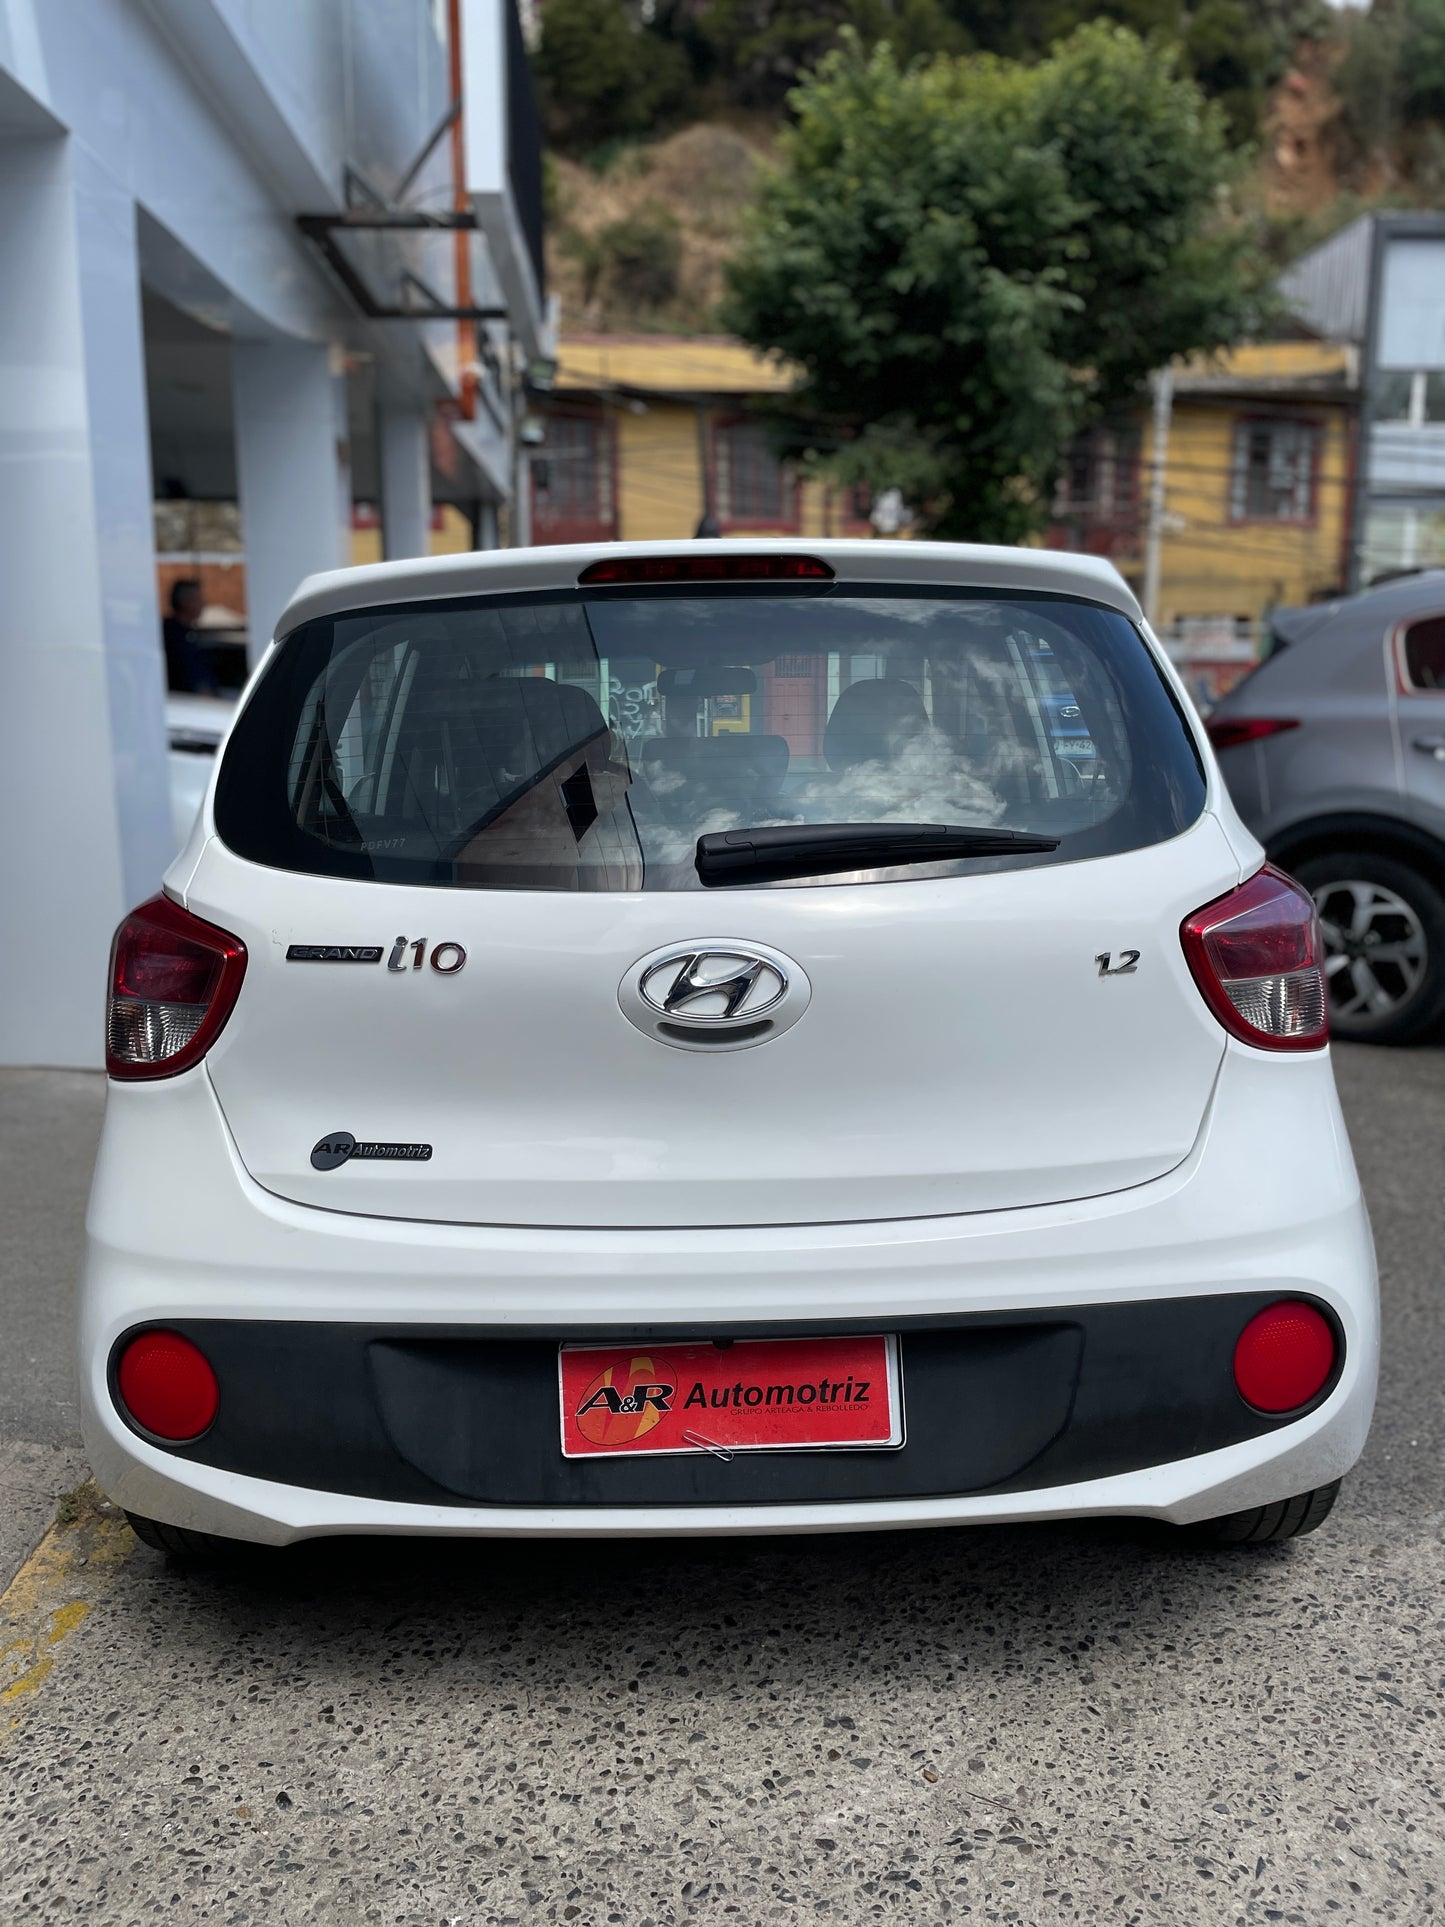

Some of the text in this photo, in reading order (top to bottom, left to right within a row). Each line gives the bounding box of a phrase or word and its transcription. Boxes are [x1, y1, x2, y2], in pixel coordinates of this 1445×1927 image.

[291, 936, 468, 974] GRAND i10
[352, 1143, 430, 1158] Automotriz
[575, 1376, 871, 1417] A&R Automotriz
[730, 1407, 763, 1416] GRUPO
[765, 1405, 804, 1415] ARTEAGA
[816, 1403, 869, 1412] REBOLLEDO
